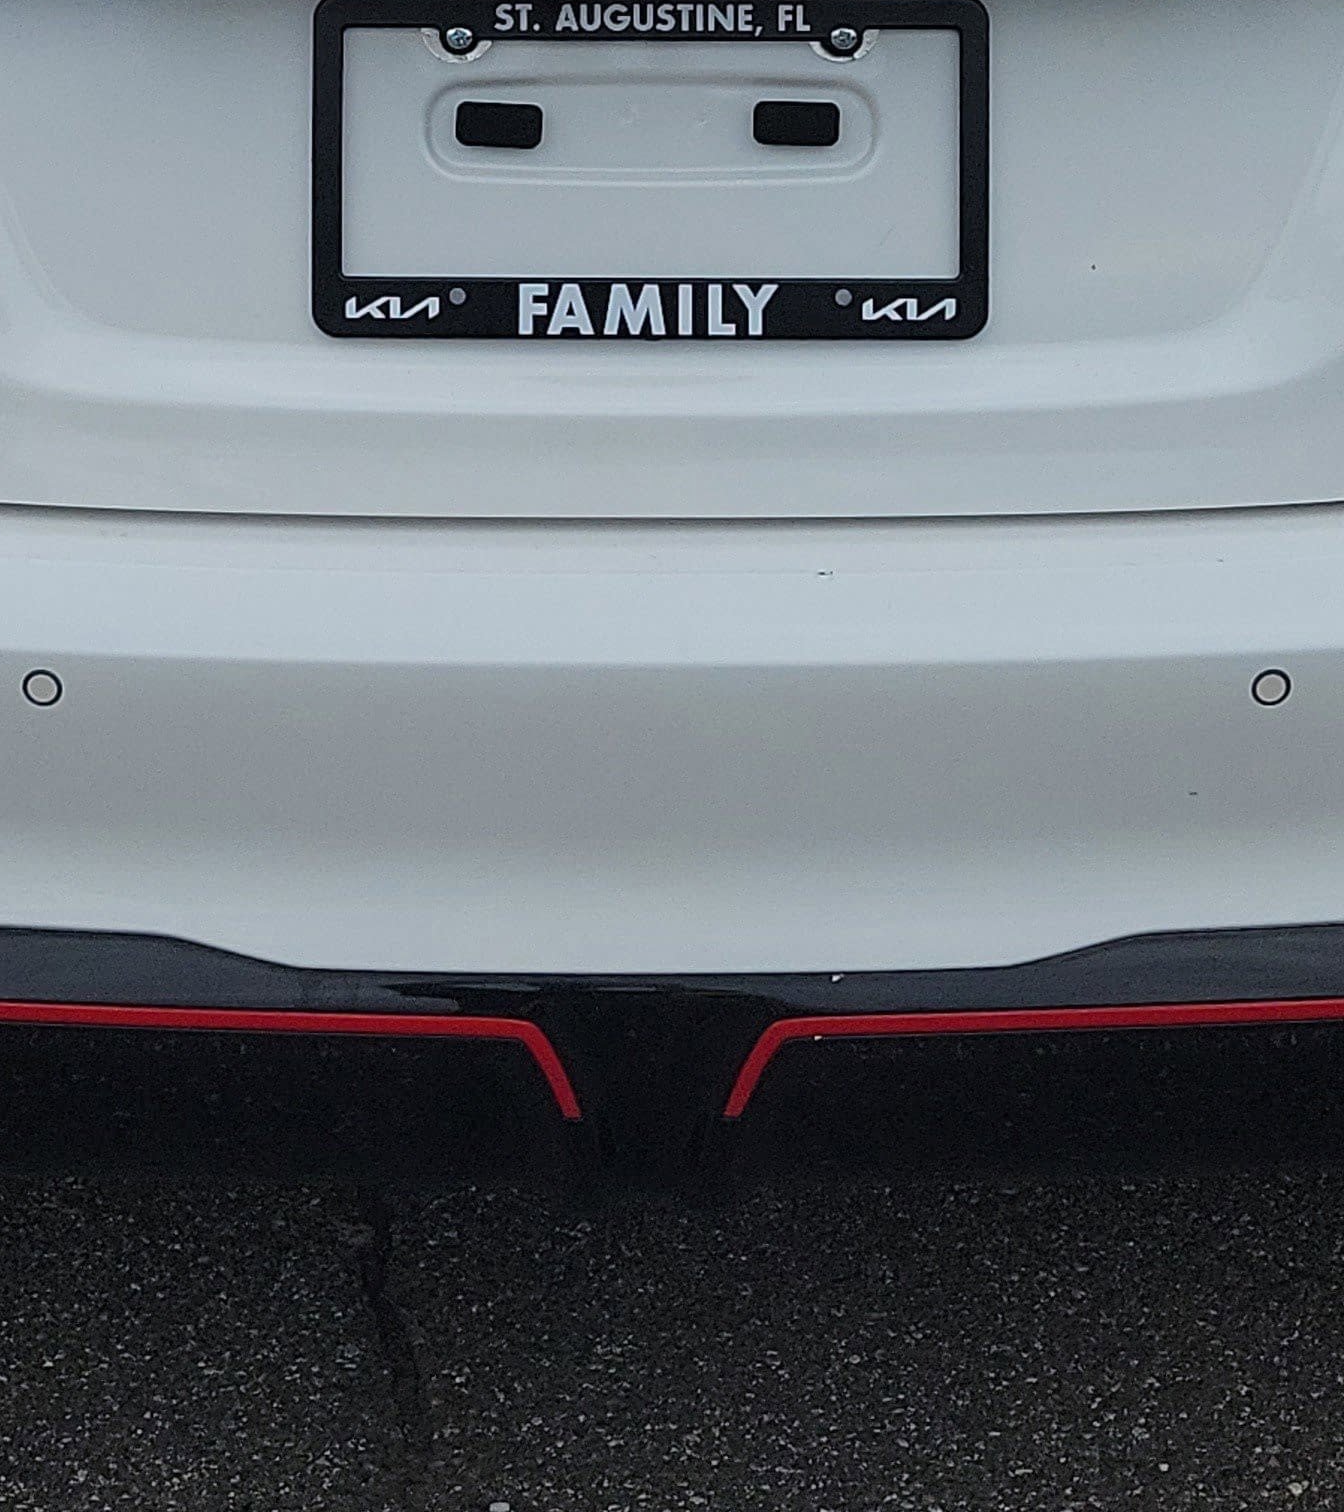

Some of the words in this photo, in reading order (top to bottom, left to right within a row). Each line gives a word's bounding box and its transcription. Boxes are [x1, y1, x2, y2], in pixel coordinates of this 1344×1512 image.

[494, 3, 541, 32] ST.
[554, 3, 763, 37] AUGUSTINE,
[777, 3, 811, 32] FL
[345, 295, 441, 321] KIA
[517, 283, 780, 336] FAMILY
[861, 296, 957, 321] KIA
